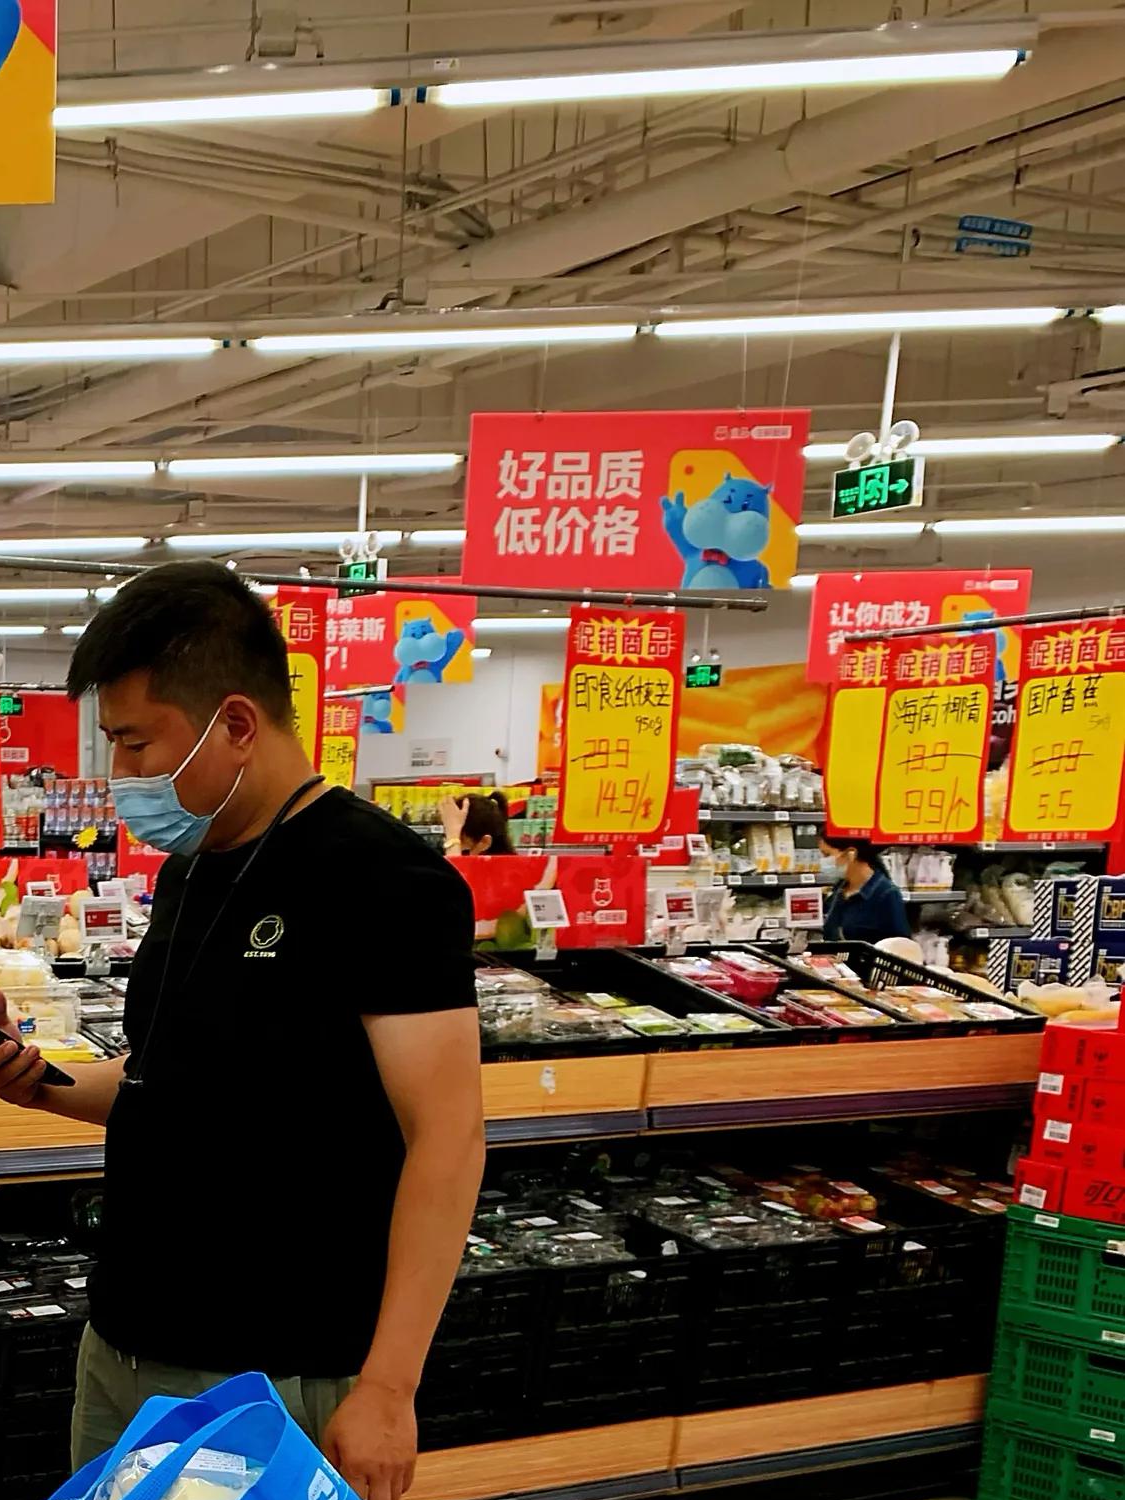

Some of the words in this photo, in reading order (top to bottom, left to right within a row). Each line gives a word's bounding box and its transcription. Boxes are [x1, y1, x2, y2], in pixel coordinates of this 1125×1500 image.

[495, 449, 645, 500] 好品质
[493, 506, 641, 557] 低价格
[828, 601, 931, 627] 让你成为
[577, 621, 672, 657] 促销商品
[1029, 632, 1125, 669] 促销商品
[896, 647, 989, 681] 促销商品
